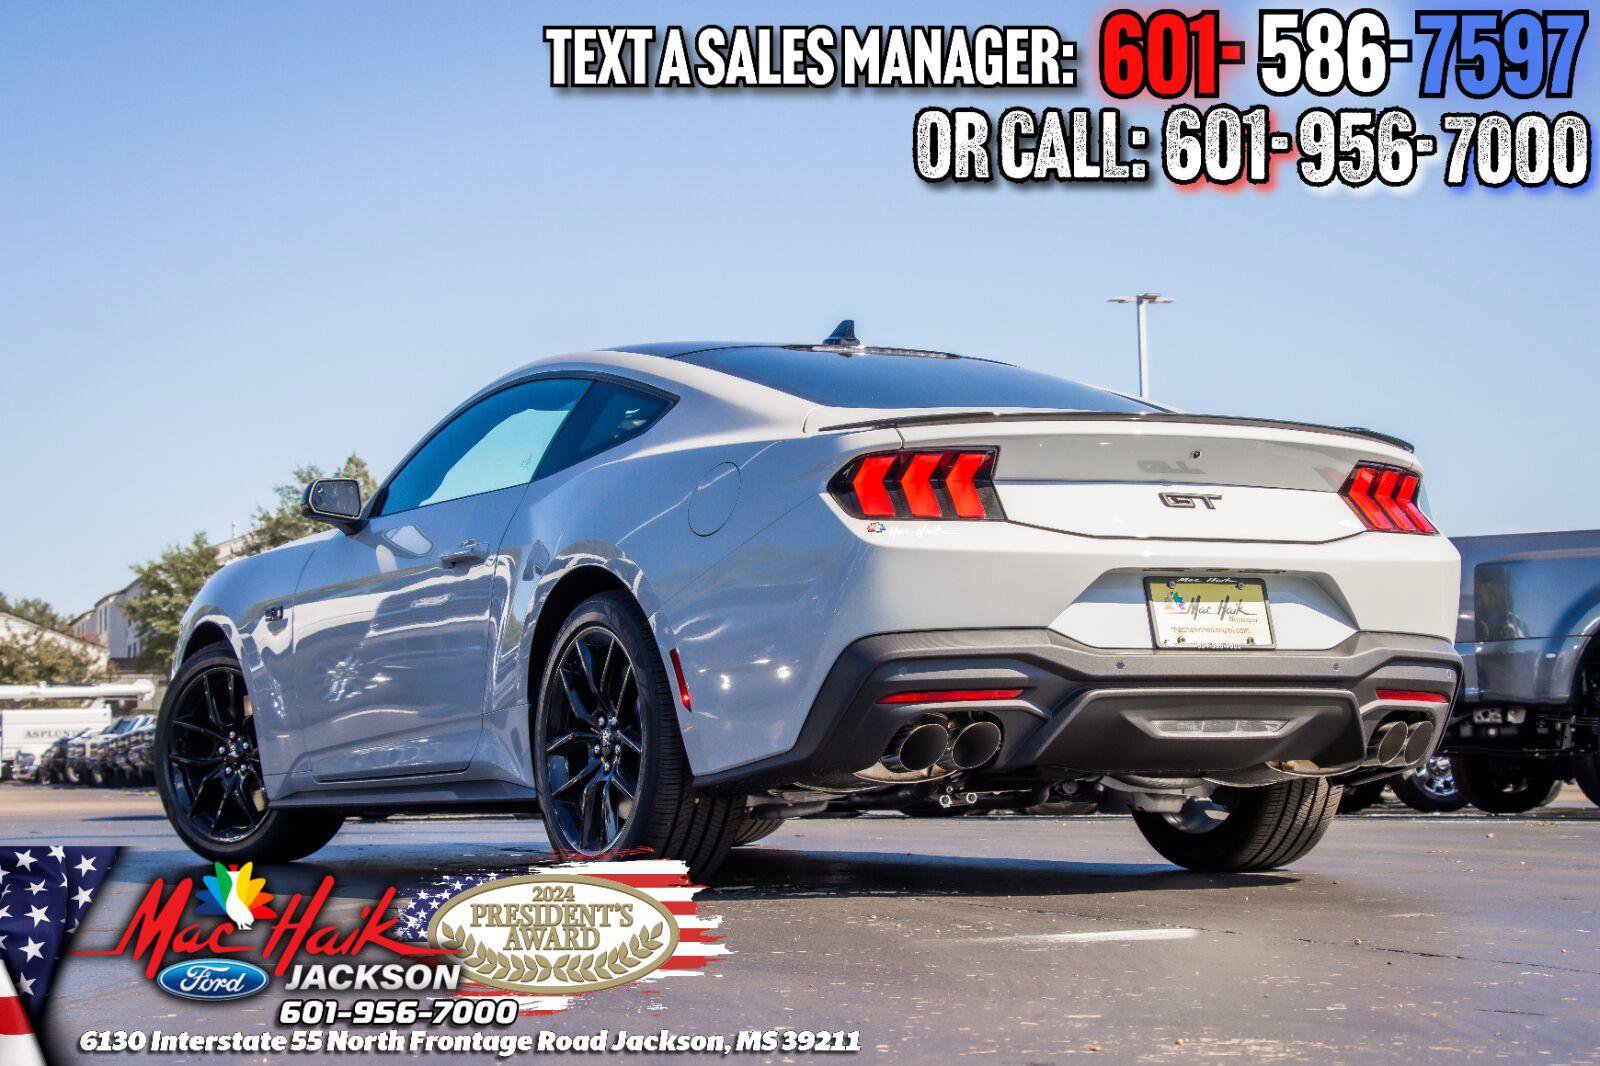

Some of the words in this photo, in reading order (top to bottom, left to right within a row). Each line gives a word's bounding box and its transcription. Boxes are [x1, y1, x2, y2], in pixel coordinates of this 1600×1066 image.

[1158, 492, 1222, 510] GT
[1174, 595, 1214, 621] Mac
[1216, 594, 1257, 621] Haik
